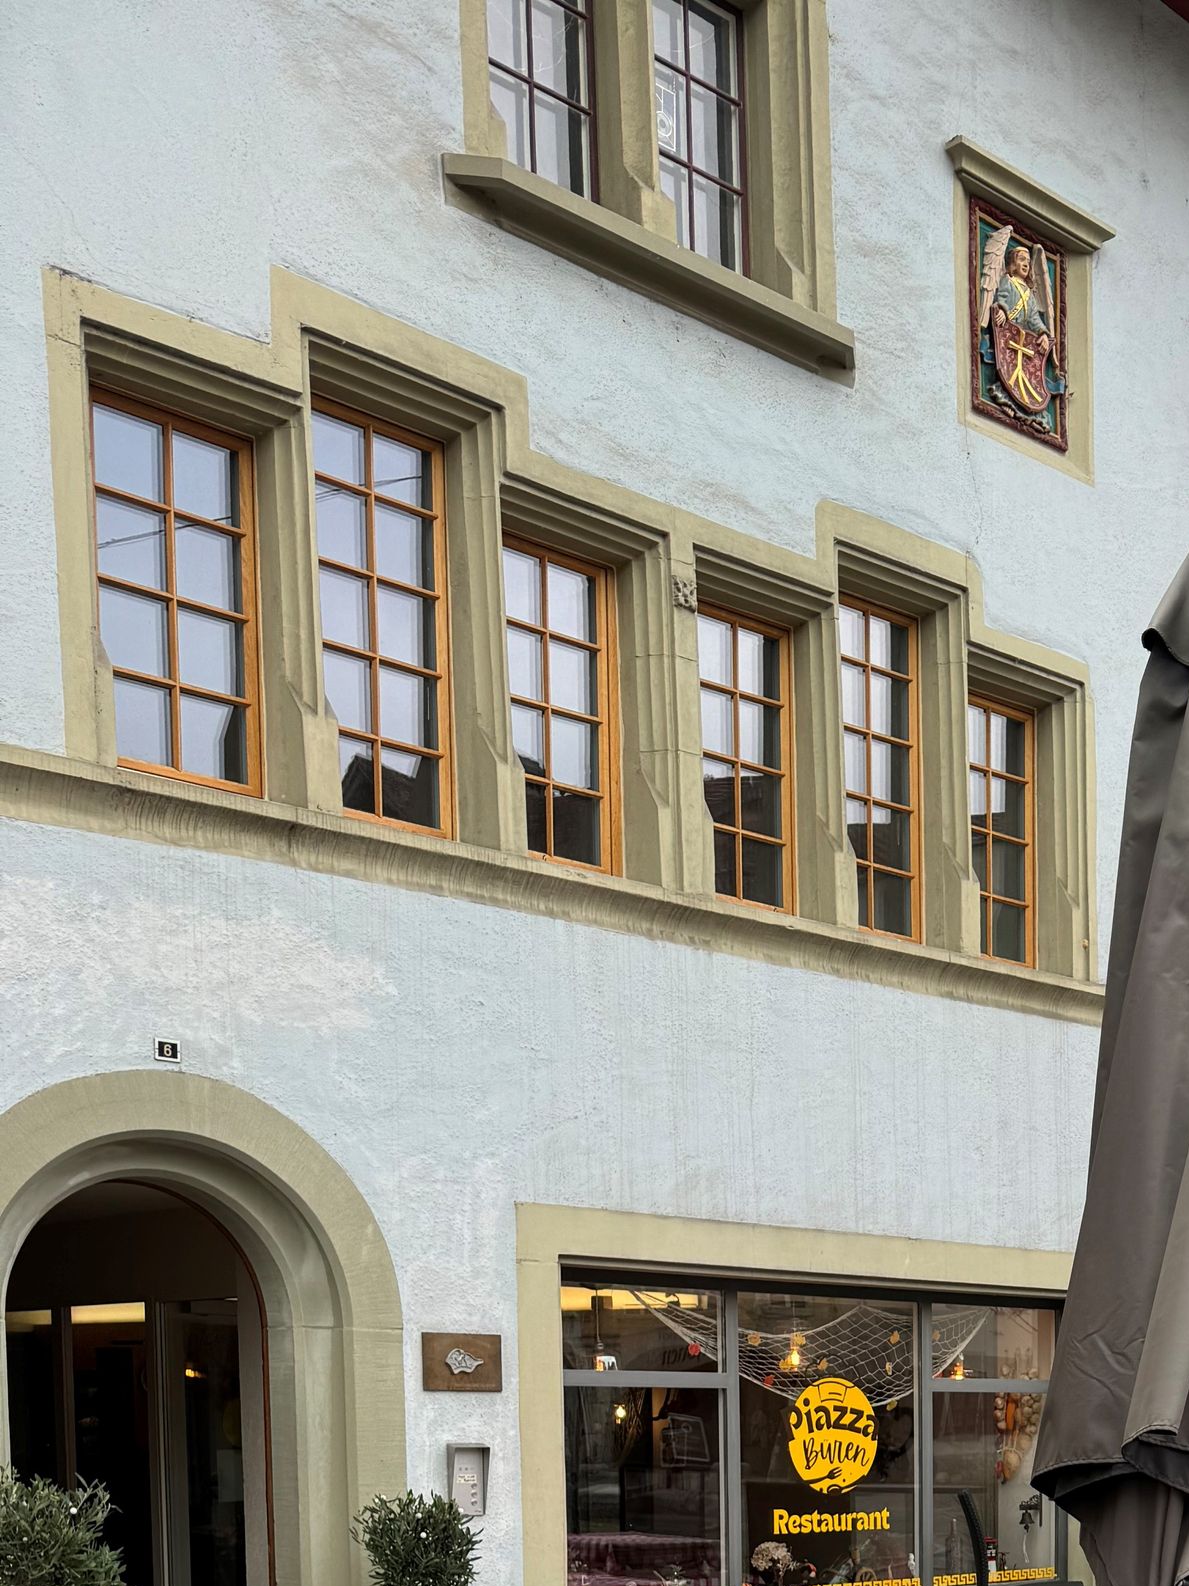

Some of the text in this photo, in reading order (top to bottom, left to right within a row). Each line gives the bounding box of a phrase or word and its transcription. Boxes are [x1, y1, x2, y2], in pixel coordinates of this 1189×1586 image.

[164, 1043, 173, 1058] 6
[803, 1438, 870, 1470] Büren
[773, 1507, 890, 1534] Restaurant
